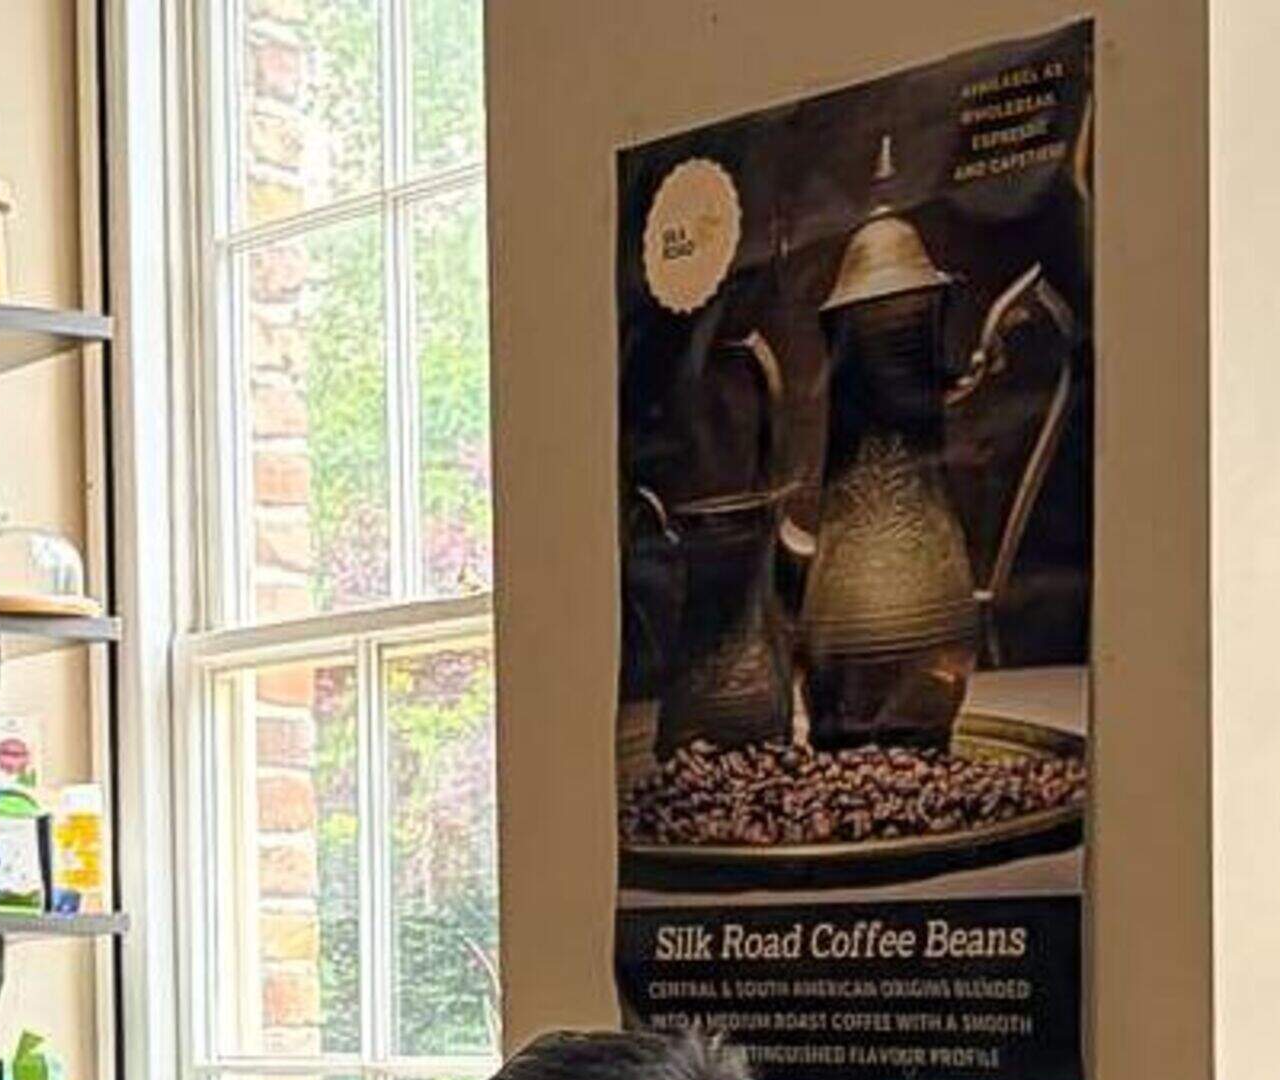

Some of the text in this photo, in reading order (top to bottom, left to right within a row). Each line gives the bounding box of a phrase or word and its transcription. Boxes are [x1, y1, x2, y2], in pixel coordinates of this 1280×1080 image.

[654, 920, 1028, 961] Silk Road Coffee Beans
[649, 979, 718, 999] CENTRAL
[735, 979, 789, 999] SOUTH
[793, 978, 877, 999] AMERICAN
[880, 978, 951, 999] ORIGINS
[953, 977, 1032, 999] BLENDED
[774, 1012, 827, 1031] ROAST
[831, 1012, 891, 1032] COFFEE
[895, 1013, 941, 1032] WITH
[945, 1013, 958, 1032] A
[962, 1013, 1033, 1034] SMOOTH
[849, 1046, 926, 1066] FLAVOUR
[930, 1047, 1000, 1068] PROFILE
